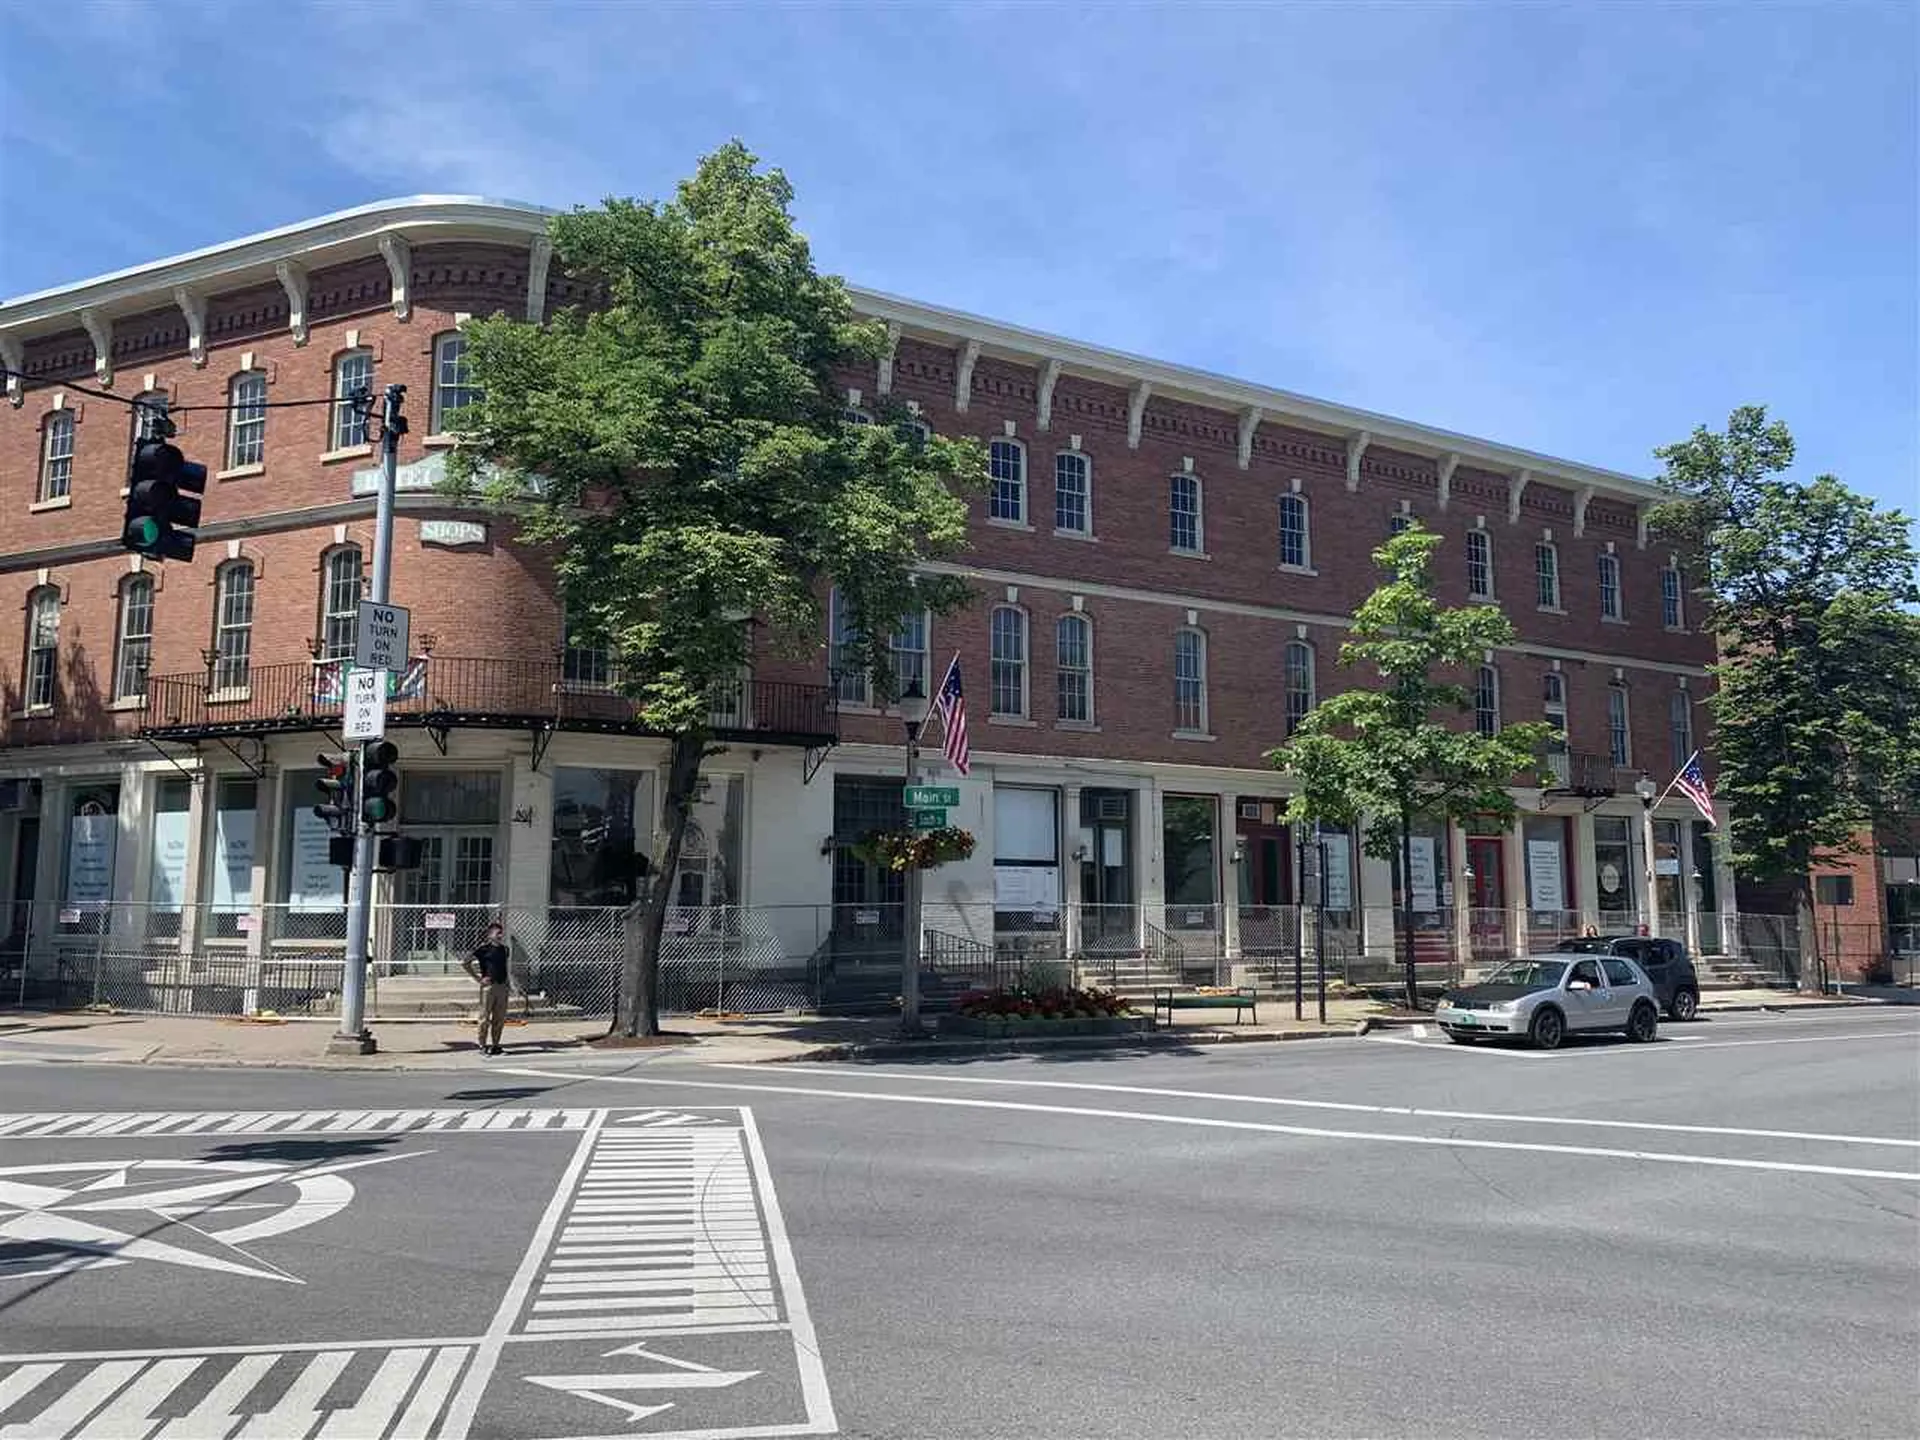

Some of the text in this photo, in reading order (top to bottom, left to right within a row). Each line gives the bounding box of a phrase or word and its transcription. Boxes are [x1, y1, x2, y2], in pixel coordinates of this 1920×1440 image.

[423, 523, 483, 539] SHOPS
[373, 609, 395, 624] NO
[370, 624, 398, 638] TURN
[374, 640, 390, 652] ON
[370, 653, 392, 666] RED
[358, 677, 375, 690] NO
[913, 791, 939, 804] Main
